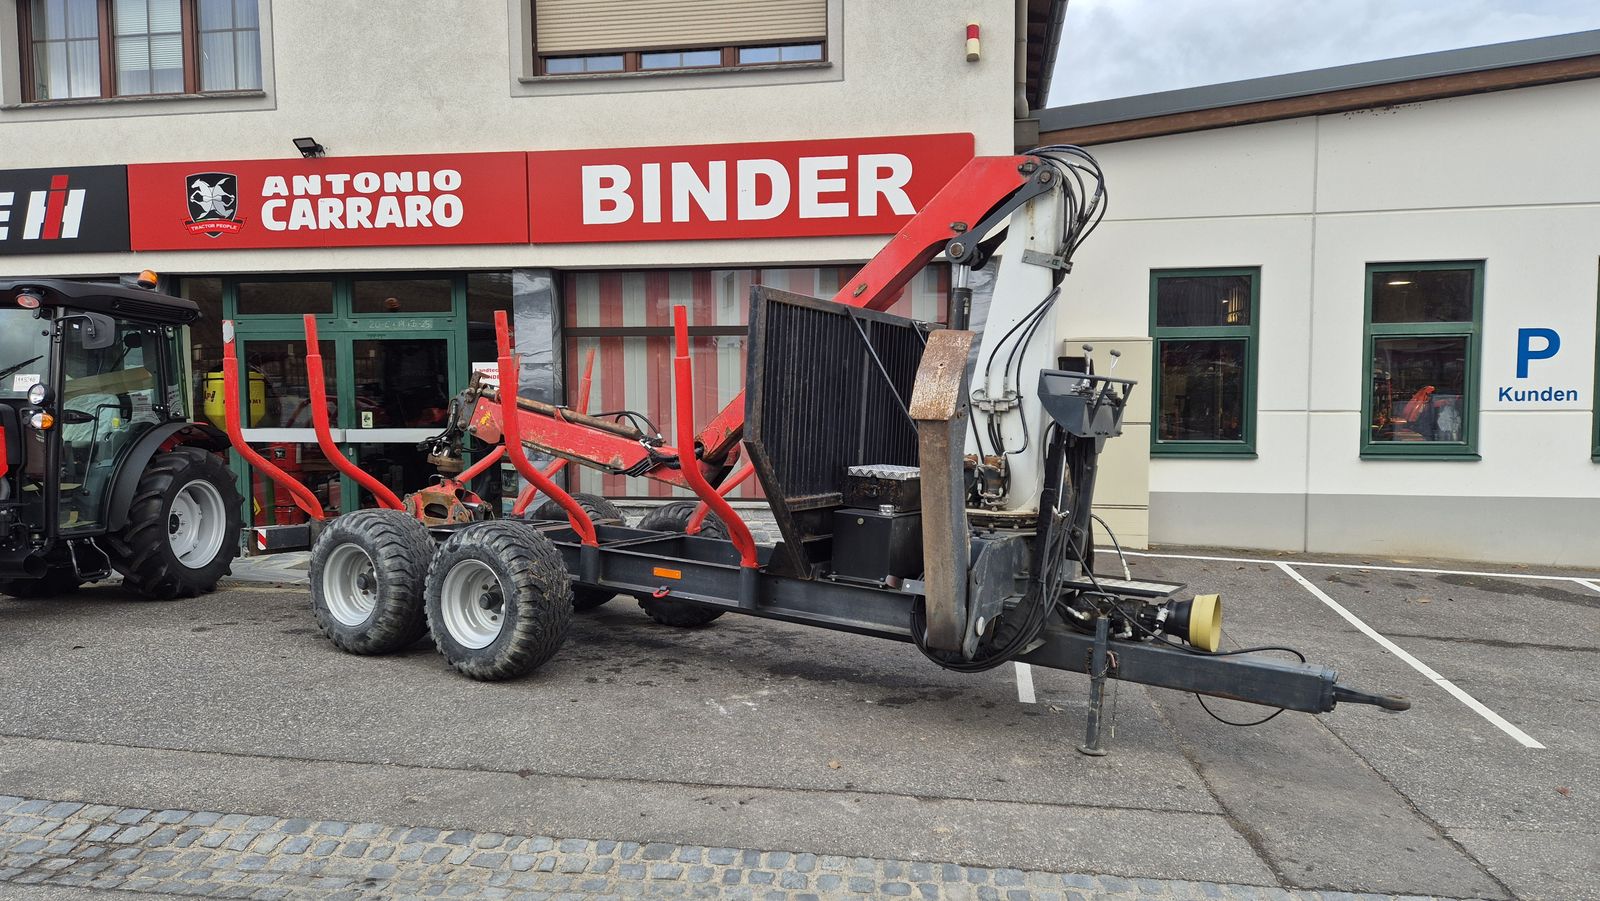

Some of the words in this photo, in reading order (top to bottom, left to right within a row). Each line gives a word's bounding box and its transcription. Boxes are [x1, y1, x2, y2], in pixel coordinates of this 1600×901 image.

[261, 169, 462, 197] ANTONIO
[581, 153, 917, 225] BINDER
[191, 223, 215, 231] TRACTOR
[261, 194, 464, 231] CARRARO
[1516, 327, 1561, 379] P
[1498, 386, 1578, 402] Kunden
